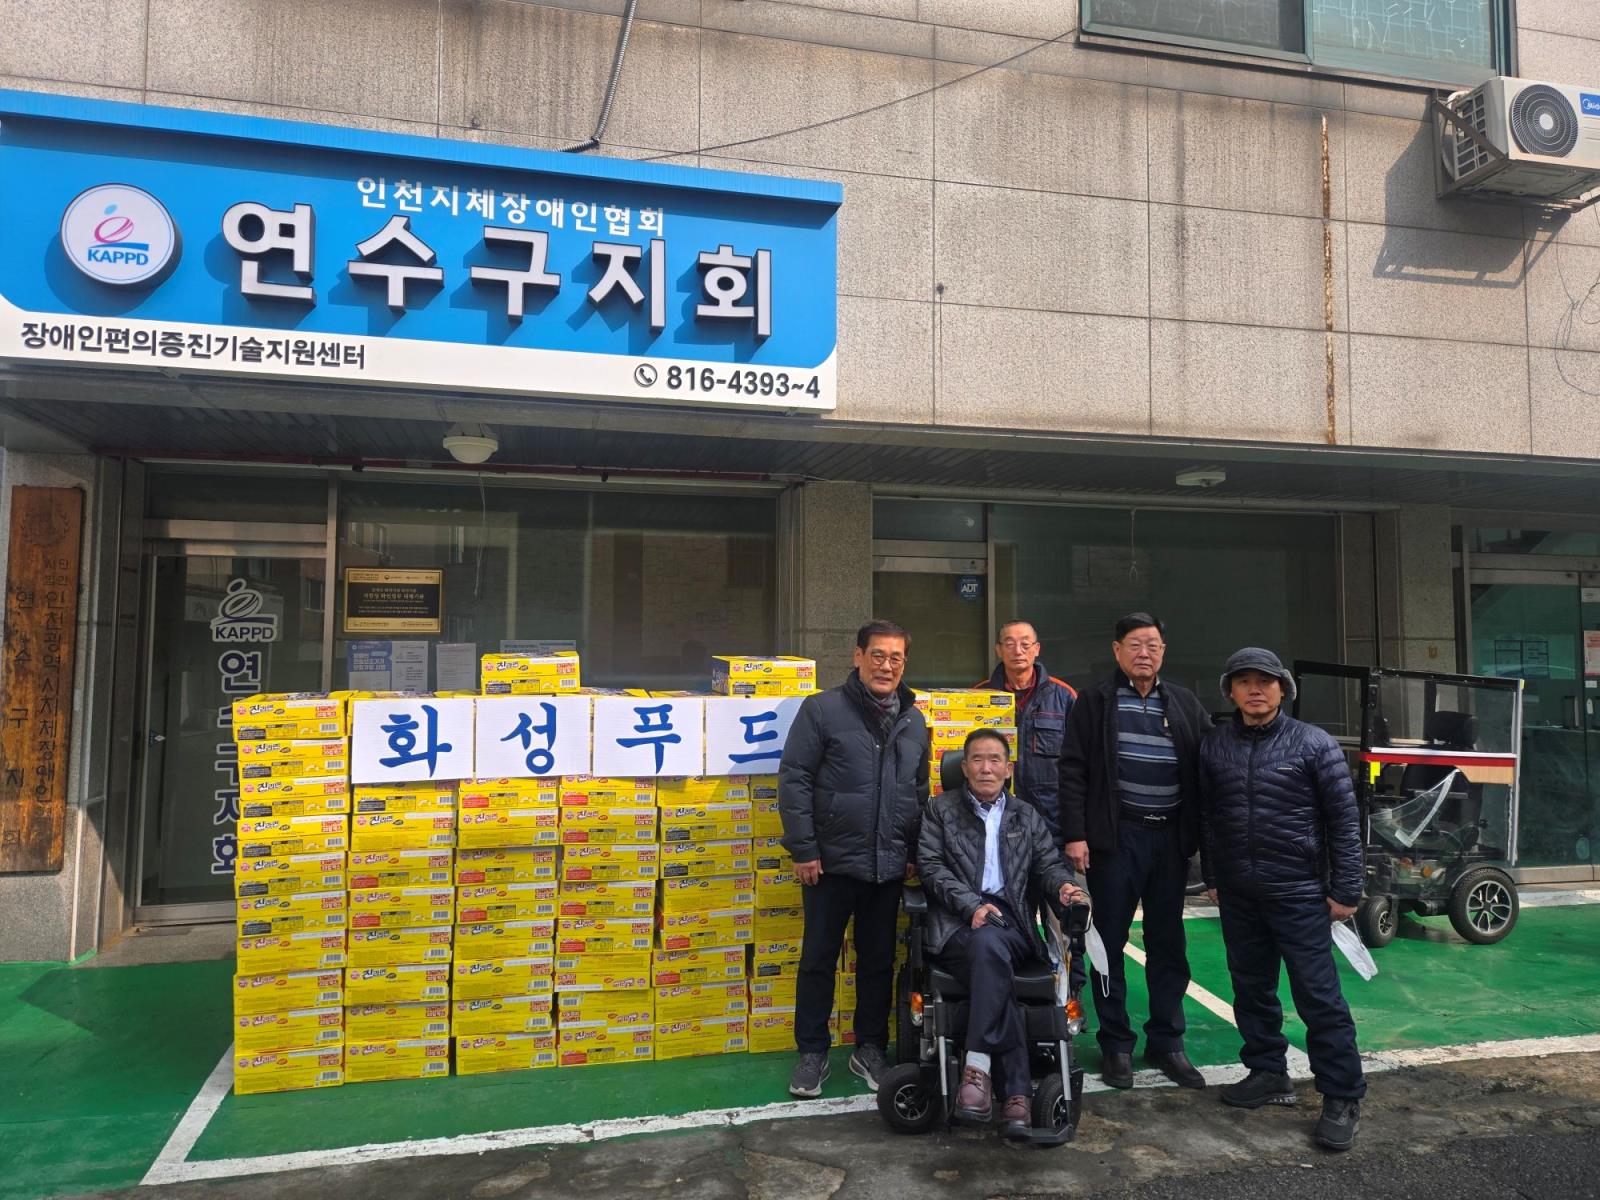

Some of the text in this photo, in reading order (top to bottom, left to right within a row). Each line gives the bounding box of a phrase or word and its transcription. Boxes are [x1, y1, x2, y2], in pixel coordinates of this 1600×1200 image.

[356, 176, 665, 238] 인천지체장애인협회
[87, 248, 149, 266] KAPPD
[221, 200, 772, 340] 연수구지회
[20, 321, 366, 370] 장애인편의증진기술지원센터
[666, 364, 821, 399] 816-4393~4
[960, 583, 978, 593] ADT
[214, 625, 275, 641] KAPPD
[379, 701, 783, 778] 화성푸드
